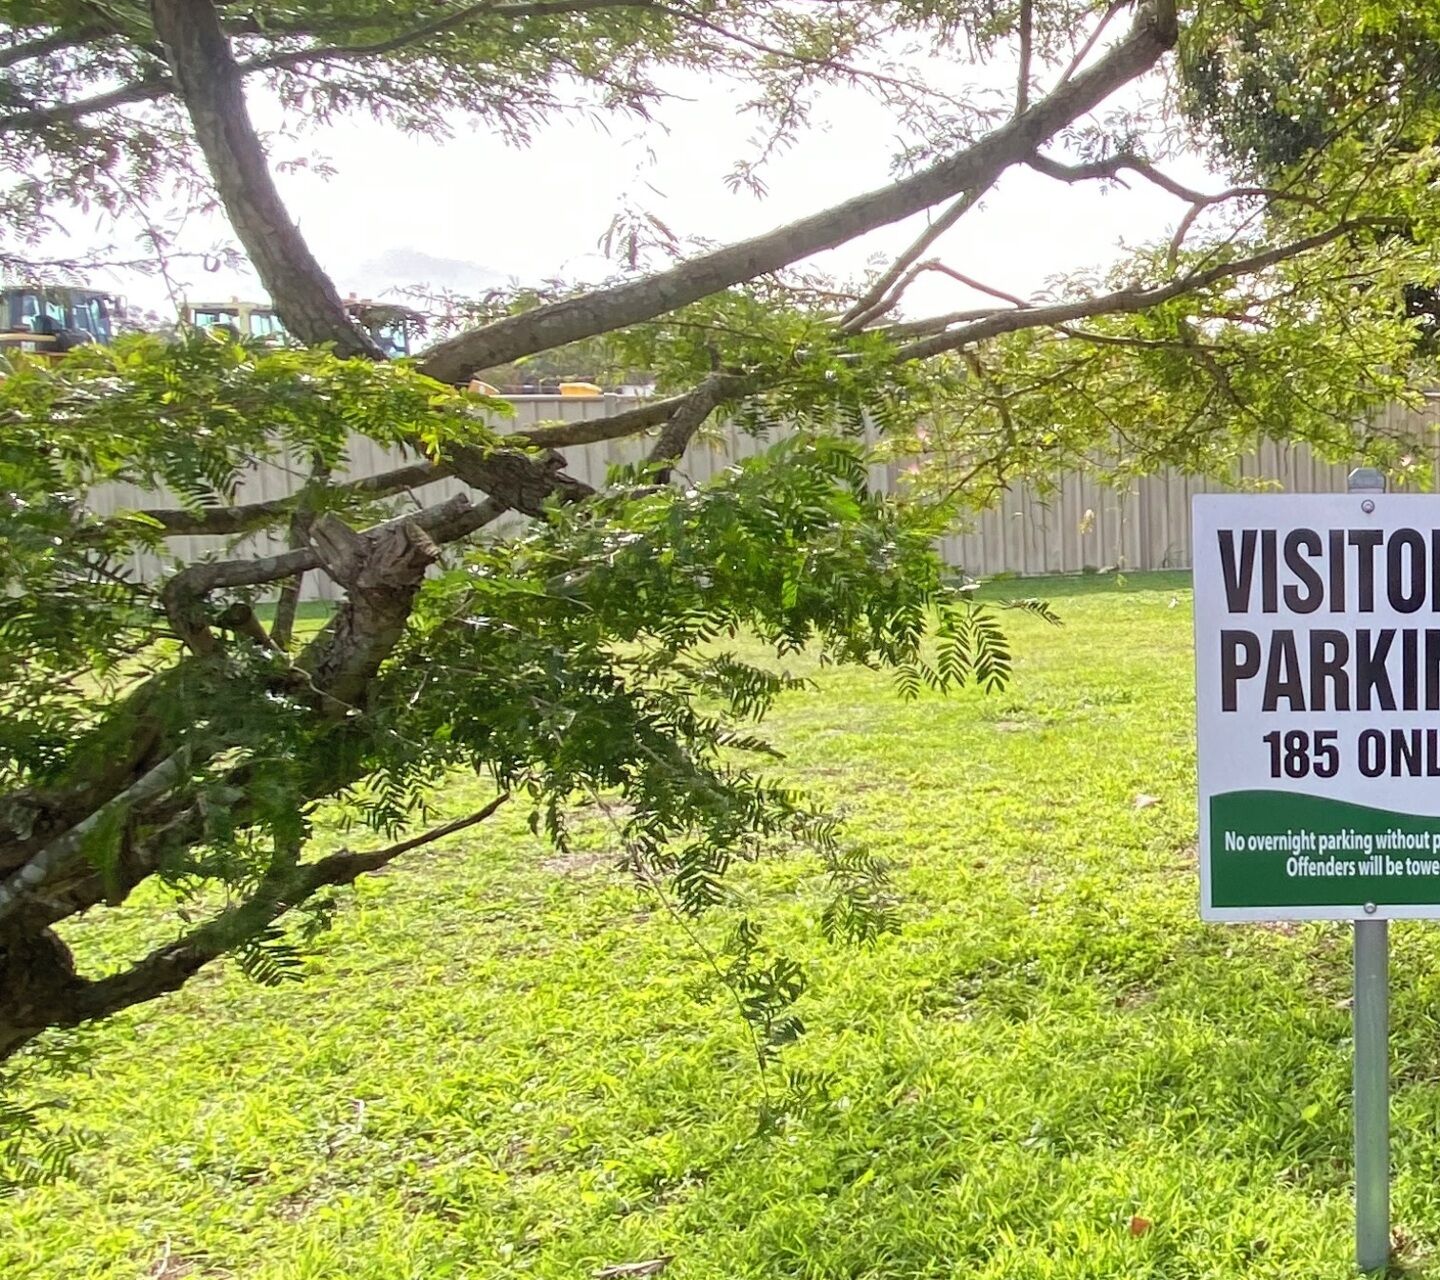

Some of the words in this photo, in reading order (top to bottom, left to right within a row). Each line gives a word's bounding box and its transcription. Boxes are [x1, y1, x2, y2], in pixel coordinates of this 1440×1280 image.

[1263, 730, 1339, 779] 185
[1225, 831, 1245, 851] No
[1248, 829, 1316, 855] overnight
[1318, 829, 1372, 855] parking
[1376, 828, 1430, 849] without
[1286, 856, 1355, 876] Offenders
[1358, 855, 1382, 875] will
[1386, 855, 1403, 875] be
